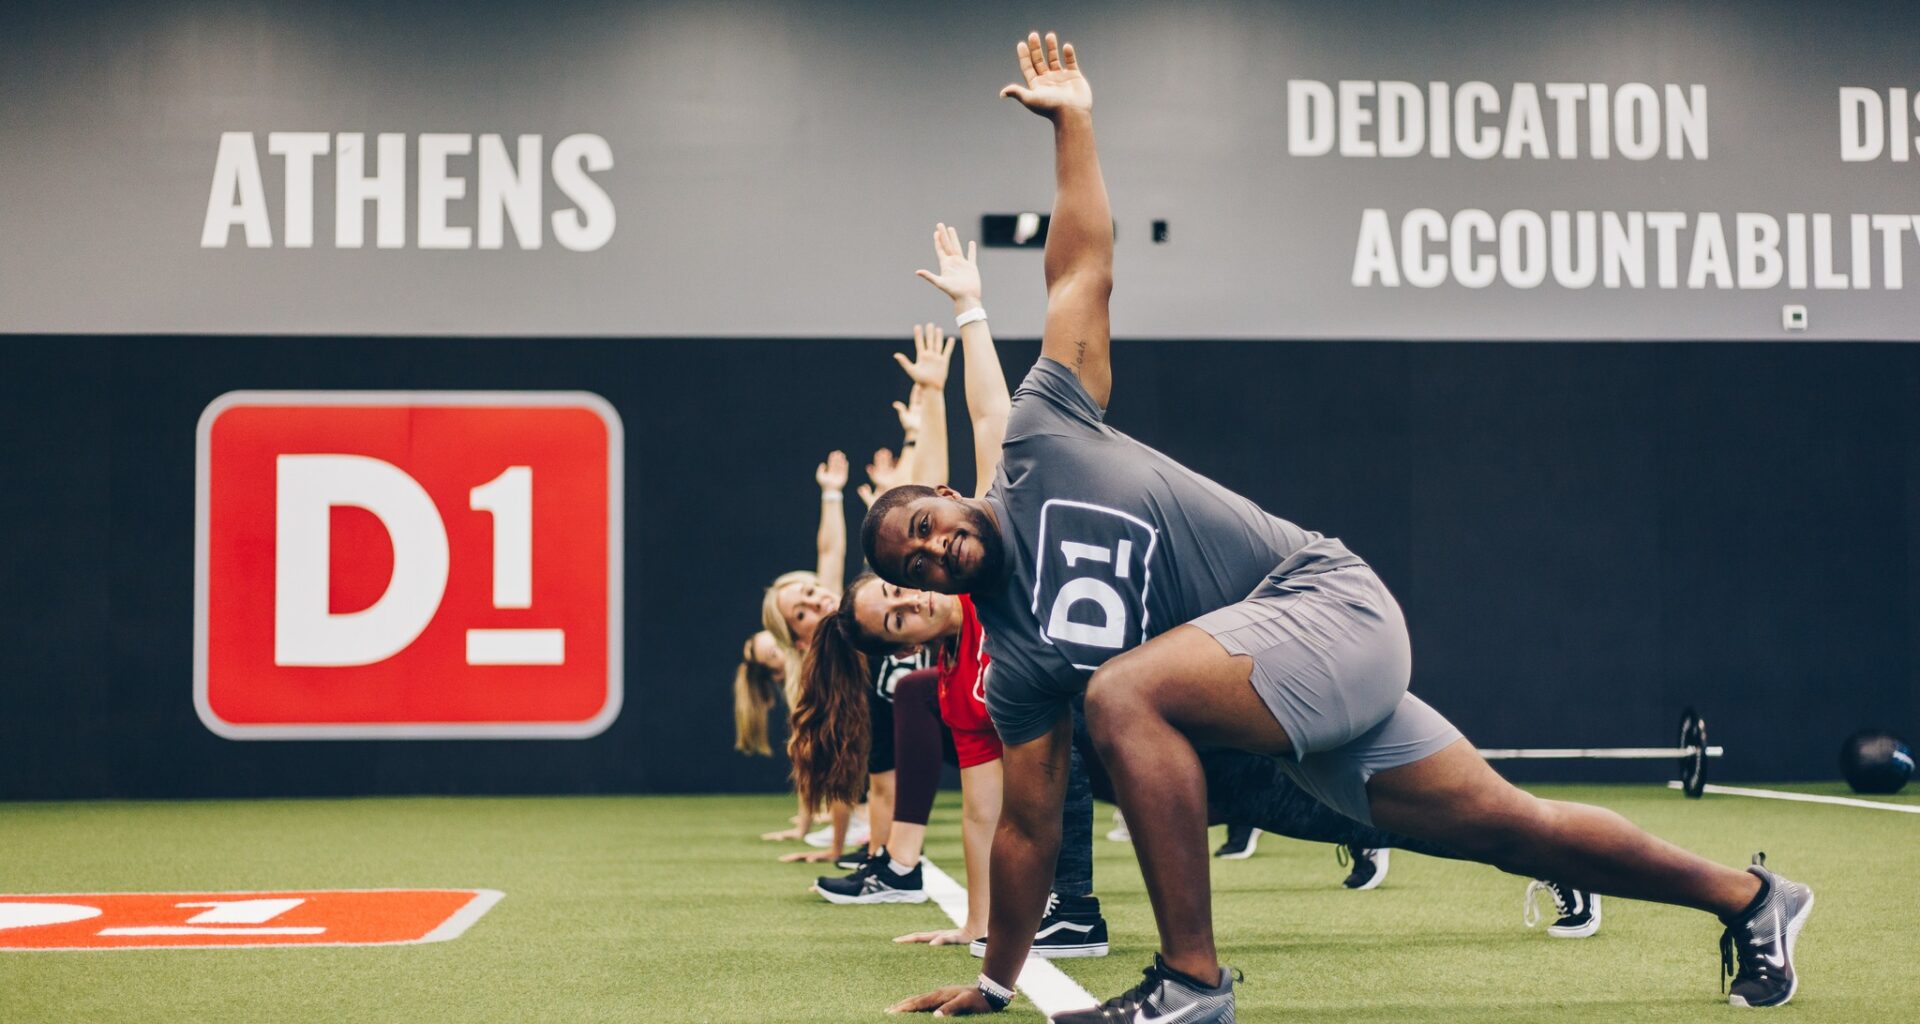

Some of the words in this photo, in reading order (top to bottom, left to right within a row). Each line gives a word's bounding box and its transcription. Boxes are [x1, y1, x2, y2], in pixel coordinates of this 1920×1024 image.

[1288, 80, 1708, 160] DEDICATION
[1840, 87, 1920, 162] DI
[200, 131, 616, 252] ATHENS
[1351, 208, 1920, 290] ACCOUNTABILIT
[275, 454, 565, 666] D1
[1047, 539, 1132, 649] D1
